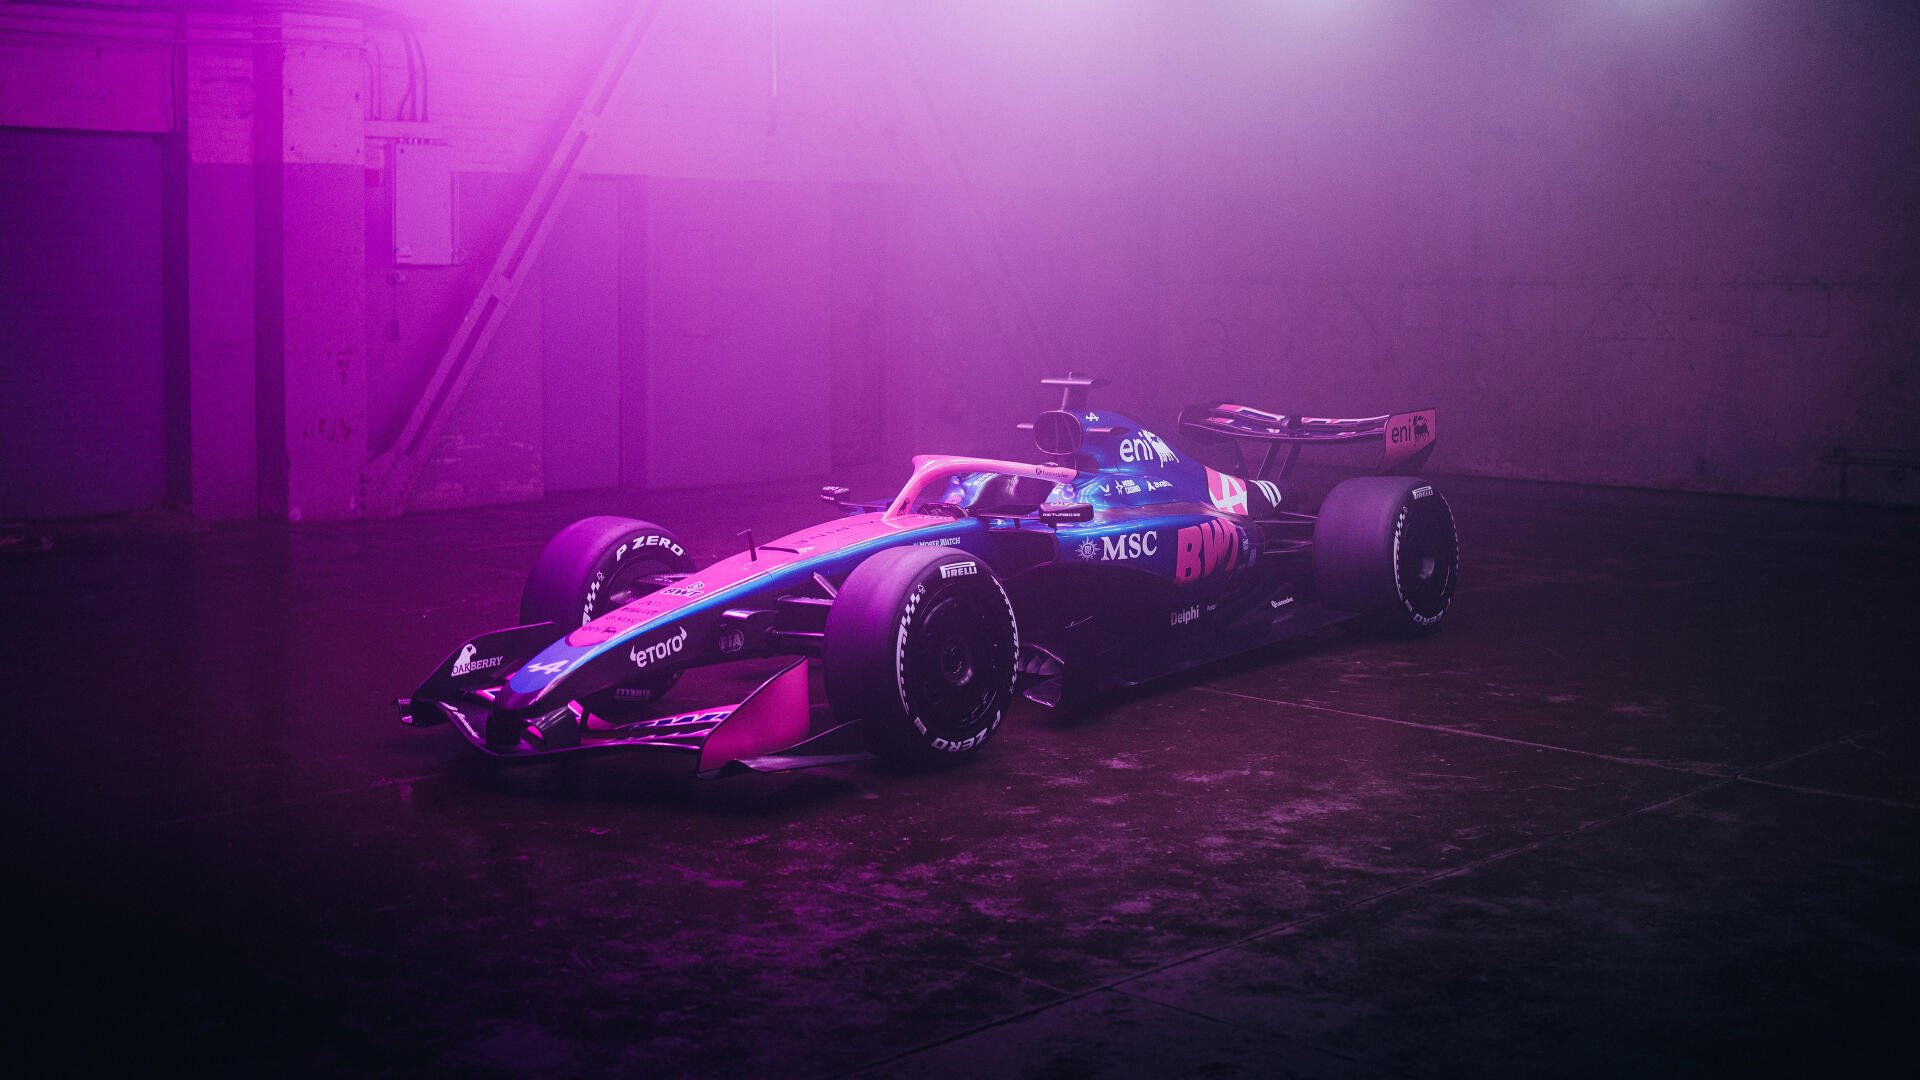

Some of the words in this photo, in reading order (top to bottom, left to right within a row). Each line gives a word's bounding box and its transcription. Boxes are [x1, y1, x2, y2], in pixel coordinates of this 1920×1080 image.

[1391, 417, 1411, 444] eni
[1119, 431, 1153, 463] eni
[1411, 485, 1434, 500] PIRELLI
[616, 543, 628, 562] P
[632, 535, 685, 557] ZERO
[1100, 530, 1158, 561] MSC
[940, 561, 978, 579] PIRELLI
[1170, 604, 1200, 626] Delphi
[453, 655, 504, 675] OAKBERRY
[930, 727, 988, 753] ZERO
